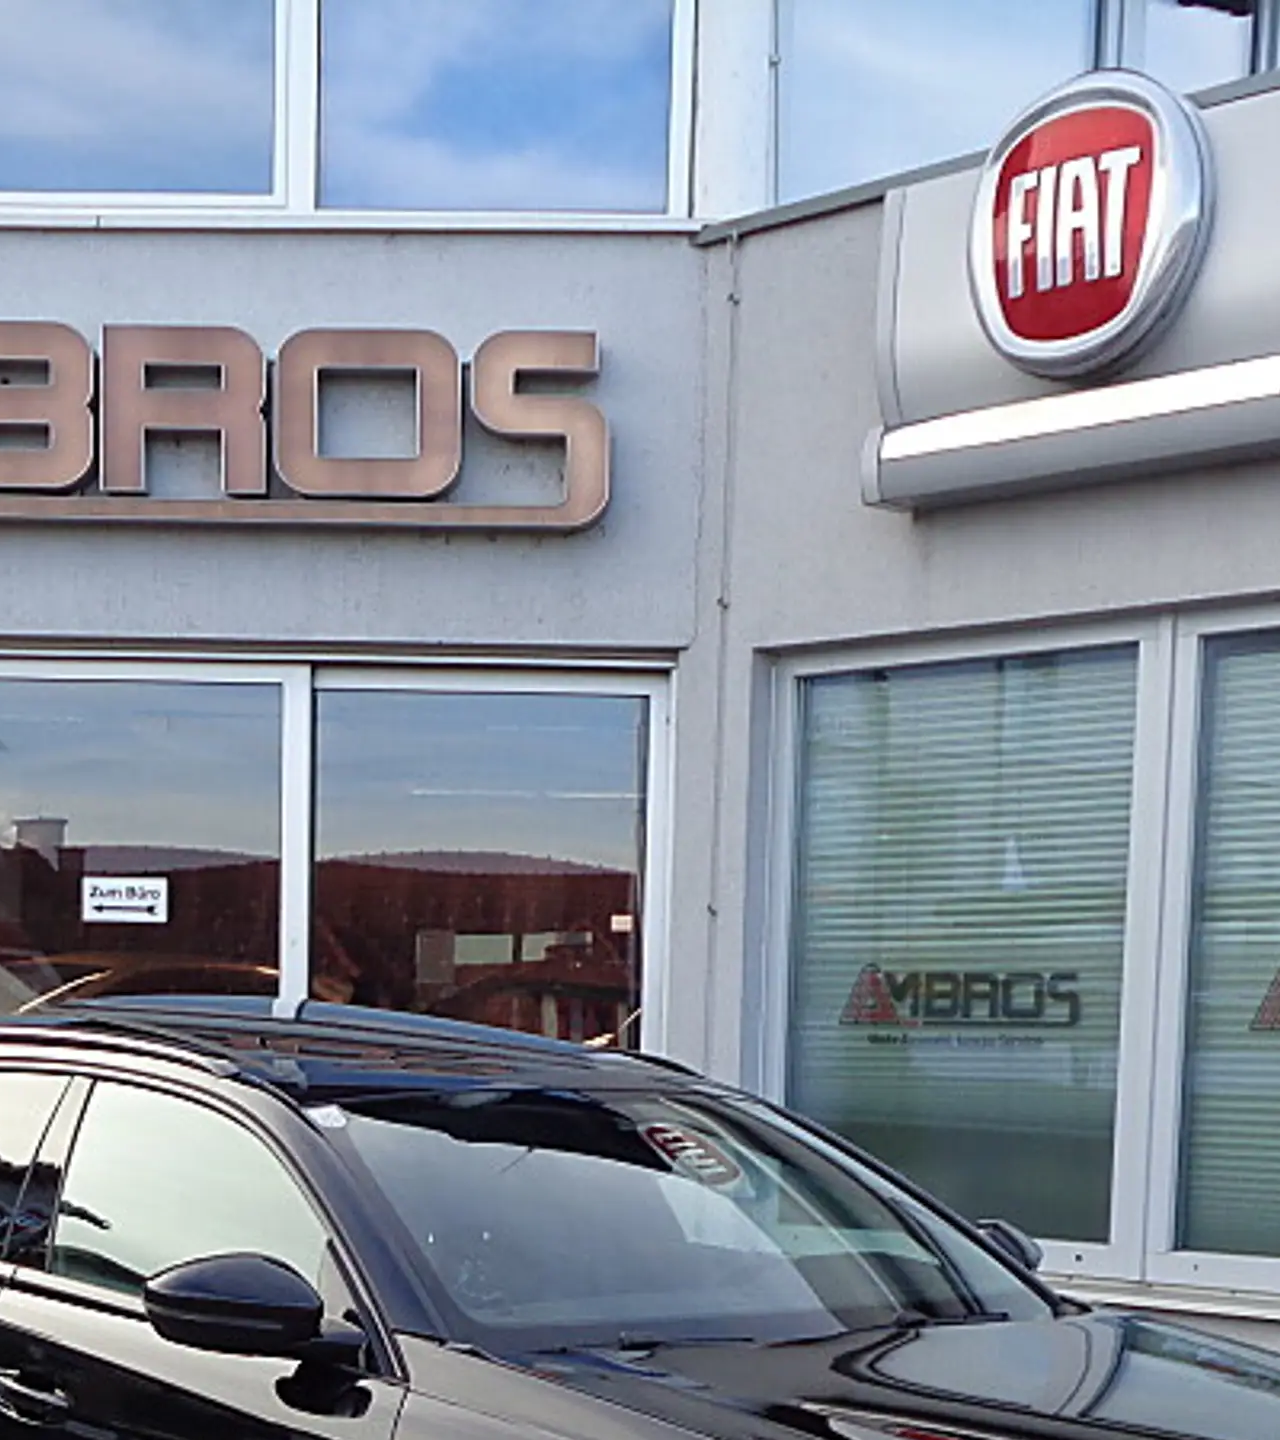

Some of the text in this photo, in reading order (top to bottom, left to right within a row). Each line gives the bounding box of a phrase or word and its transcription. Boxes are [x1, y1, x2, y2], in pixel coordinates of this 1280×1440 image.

[1007, 146, 1142, 300] FIAT
[89, 885, 161, 900] Zum Büro
[838, 962, 1082, 1027] AMBROS
